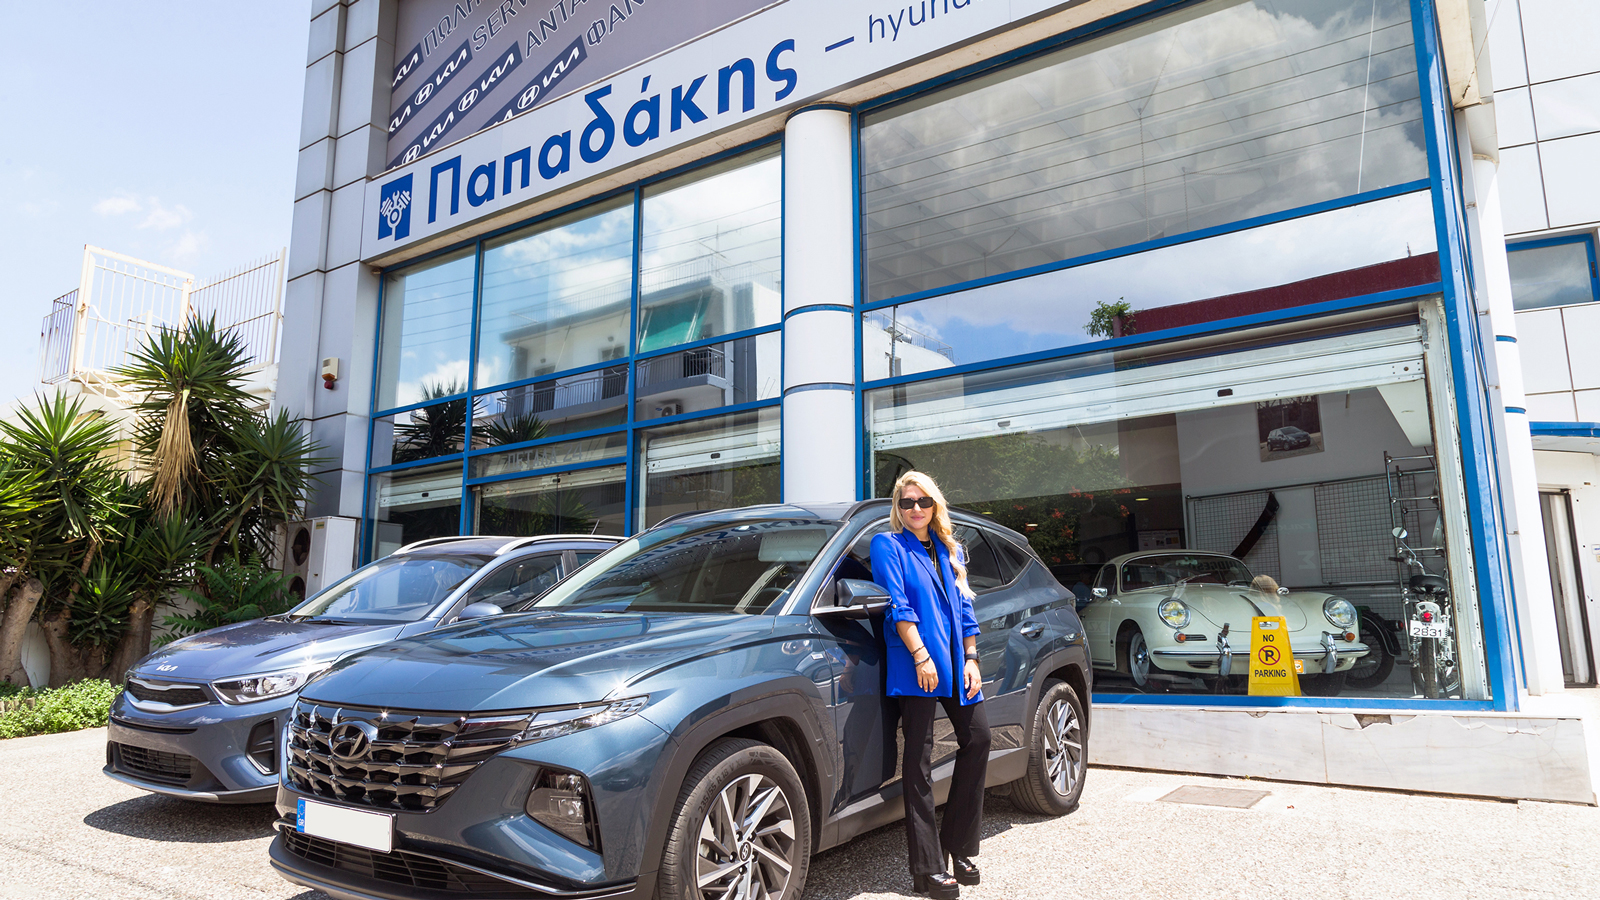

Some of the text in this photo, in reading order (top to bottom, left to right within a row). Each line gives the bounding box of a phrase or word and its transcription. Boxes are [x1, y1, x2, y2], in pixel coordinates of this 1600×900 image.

[427, 38, 798, 225] Παπαδάκης
[562, 441, 583, 463] 24
[1413, 627, 1442, 637] 2831
[1262, 634, 1275, 643] NO
[1254, 669, 1287, 678] PARKING
